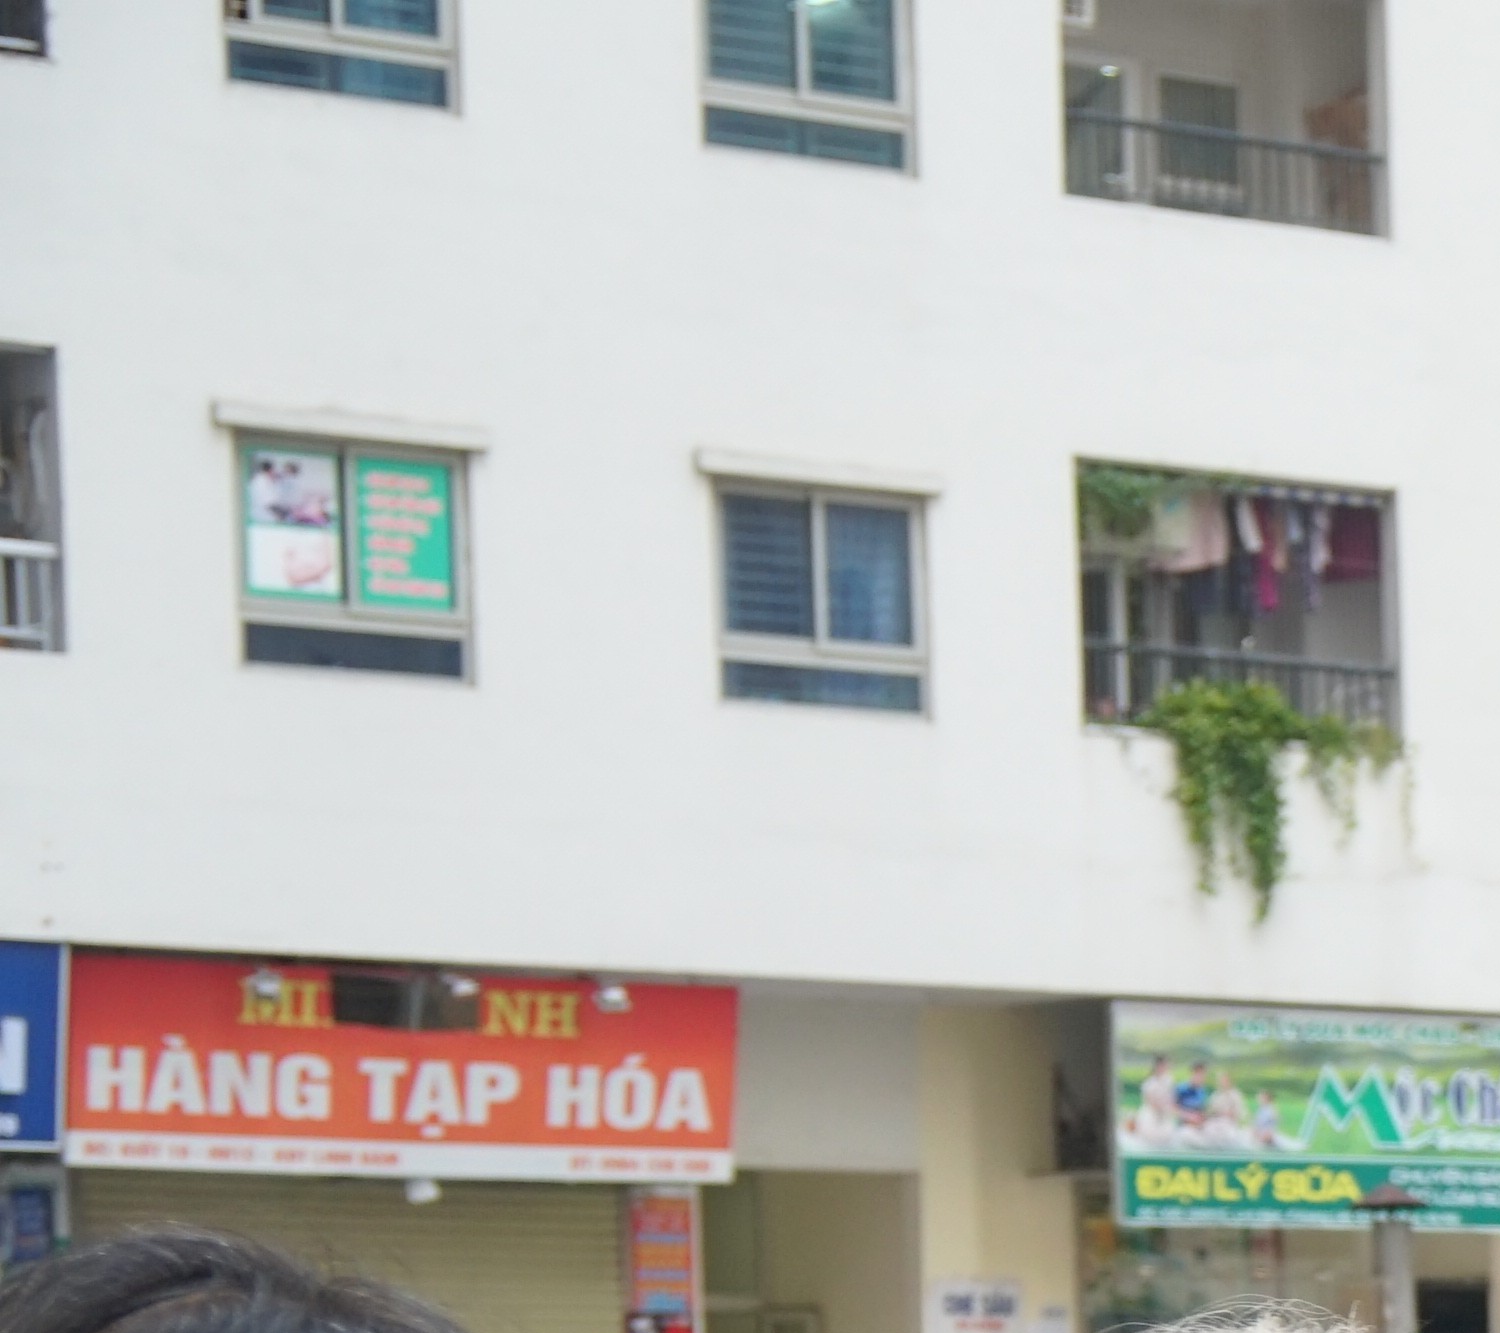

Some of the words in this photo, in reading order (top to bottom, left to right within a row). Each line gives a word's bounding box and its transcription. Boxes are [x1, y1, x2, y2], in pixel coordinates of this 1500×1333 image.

[85, 1034, 332, 1120] HÀNG
[357, 1058, 522, 1139] TẠP
[545, 1052, 714, 1133] HÓA
[1135, 1164, 1211, 1206] ĐẠI
[1213, 1161, 1270, 1201] LÝ
[1271, 1162, 1363, 1204] SỮA
